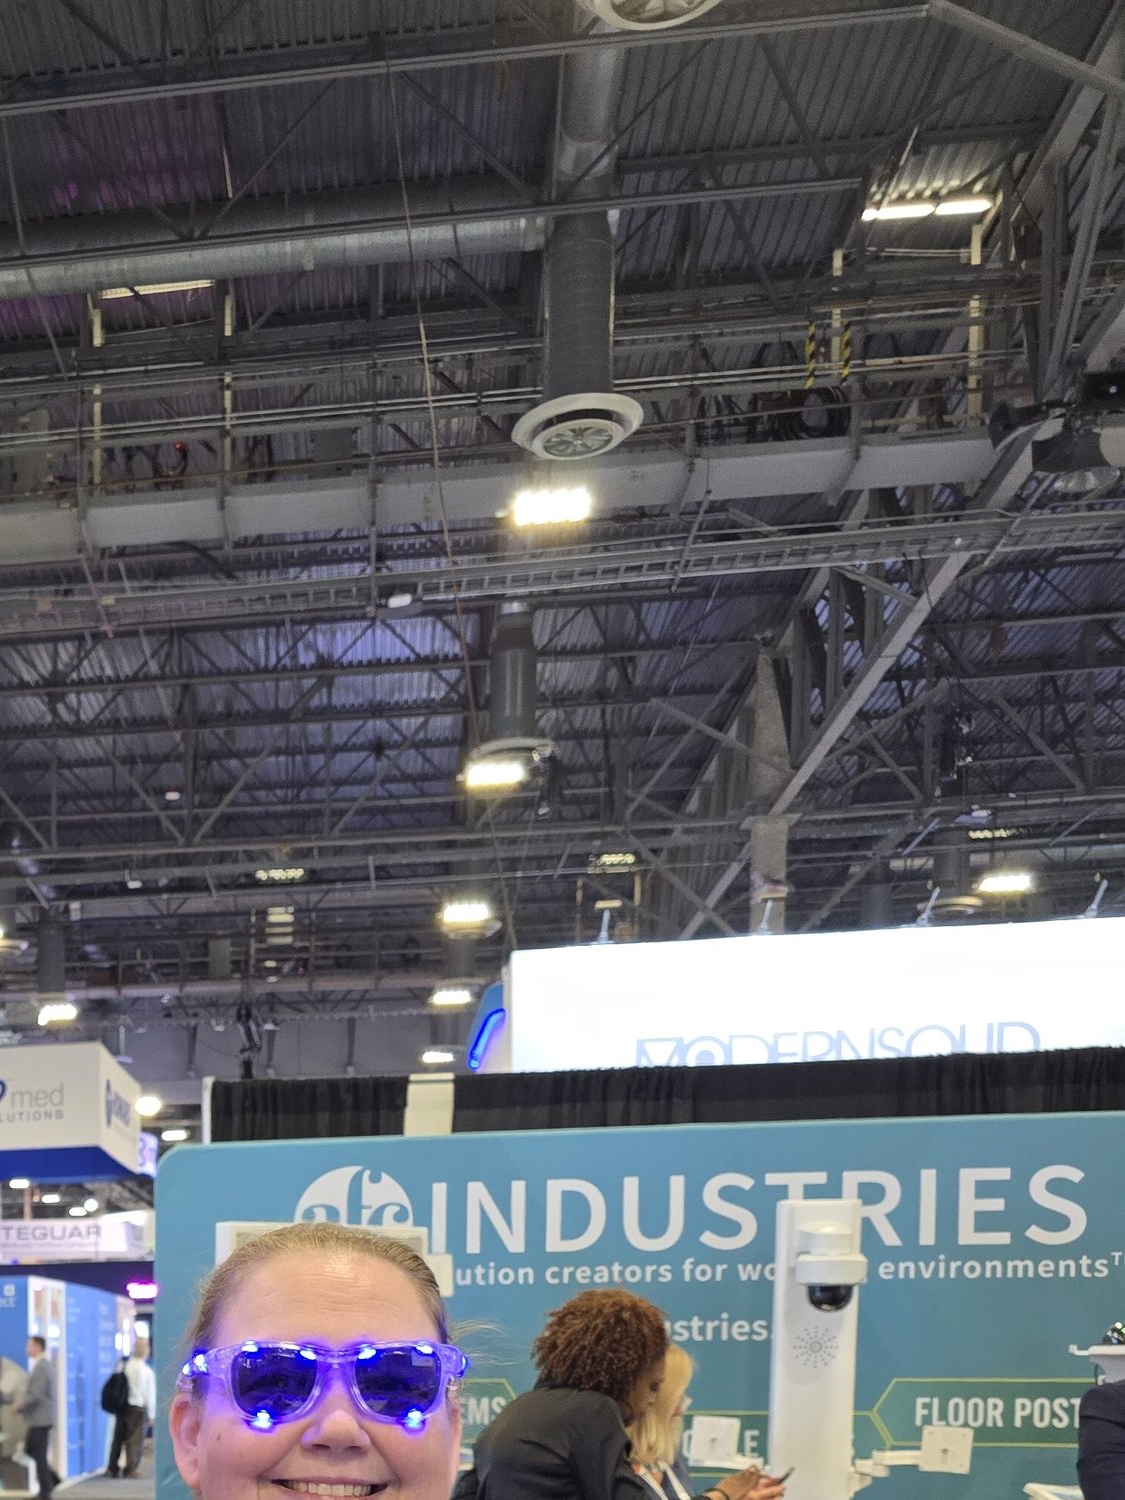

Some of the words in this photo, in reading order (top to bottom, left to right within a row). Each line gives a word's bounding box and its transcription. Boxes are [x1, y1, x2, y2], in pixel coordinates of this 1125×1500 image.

[0, 1223, 103, 1242] TEGUAR
[455, 1263, 535, 1286] ution
[545, 1259, 673, 1284] creators
[682, 1258, 728, 1283] for
[915, 1397, 1004, 1428] FLOOR
